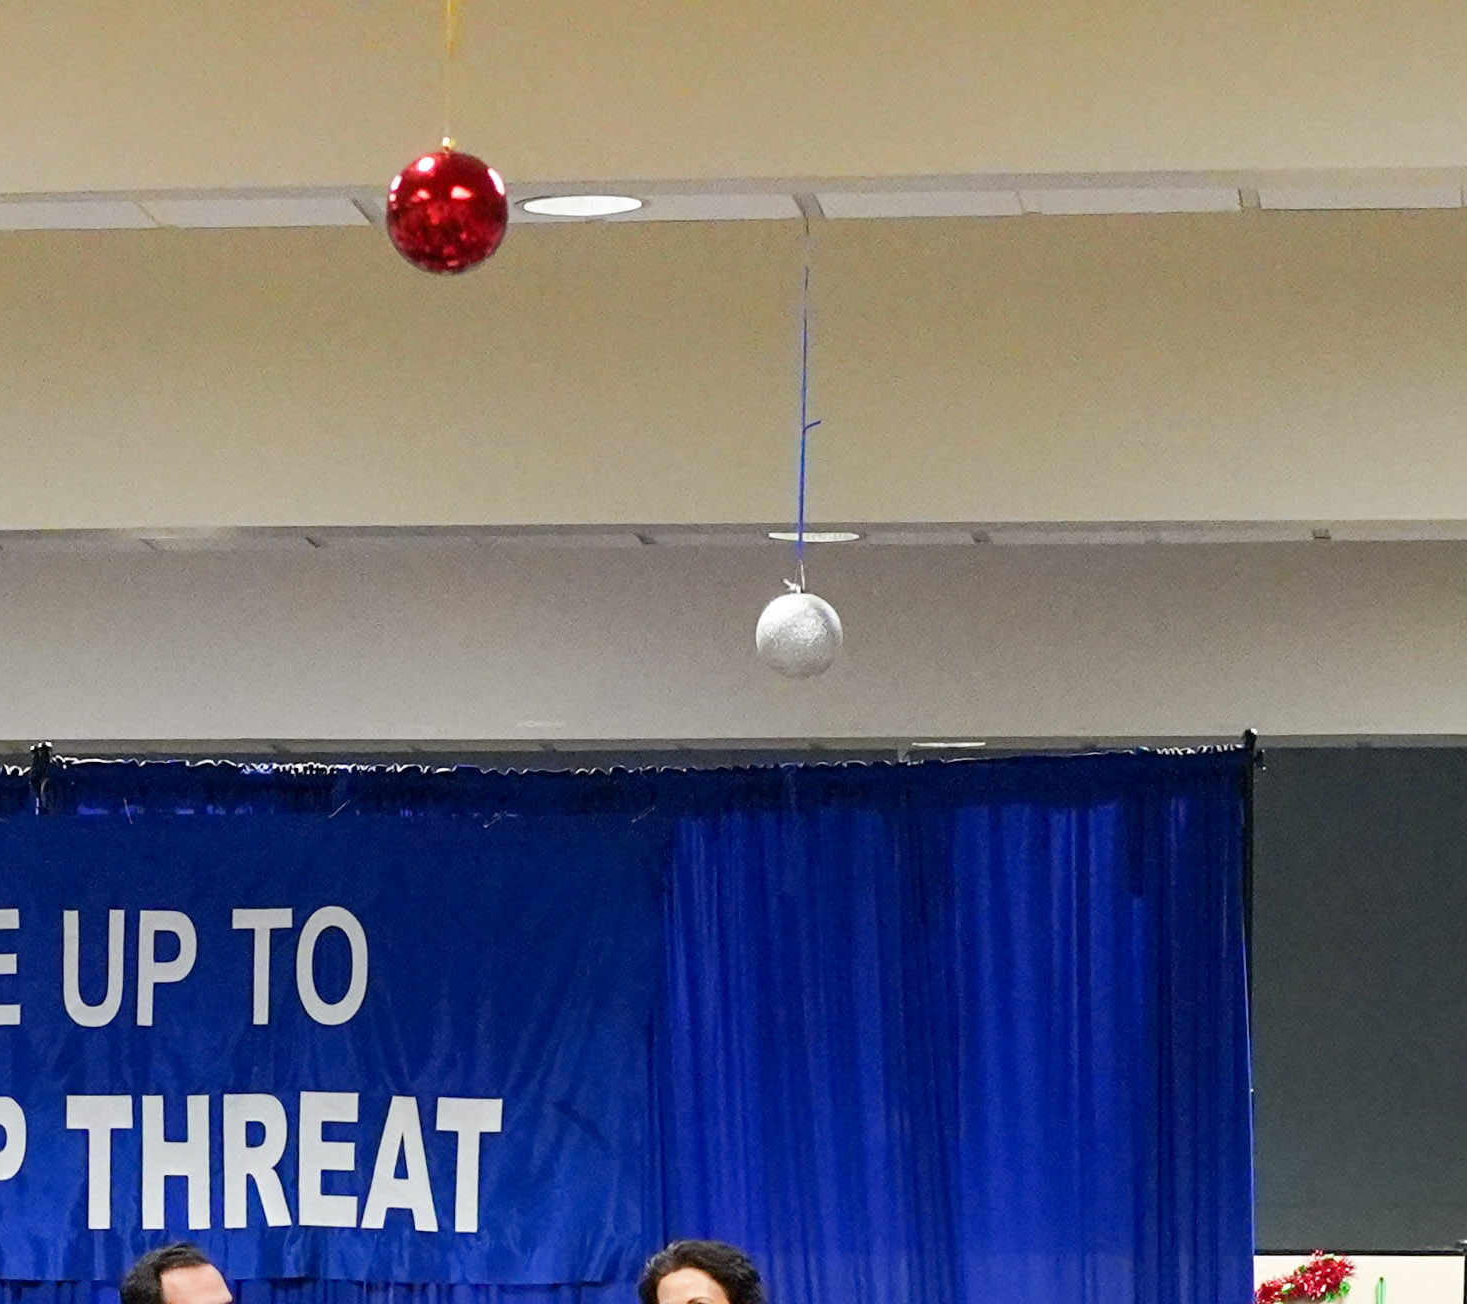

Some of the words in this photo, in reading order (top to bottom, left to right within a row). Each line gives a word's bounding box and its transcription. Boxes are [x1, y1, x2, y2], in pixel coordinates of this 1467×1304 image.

[64, 910, 196, 1027] UP
[233, 906, 367, 1025] TO
[67, 1092, 502, 1232] THREAT
